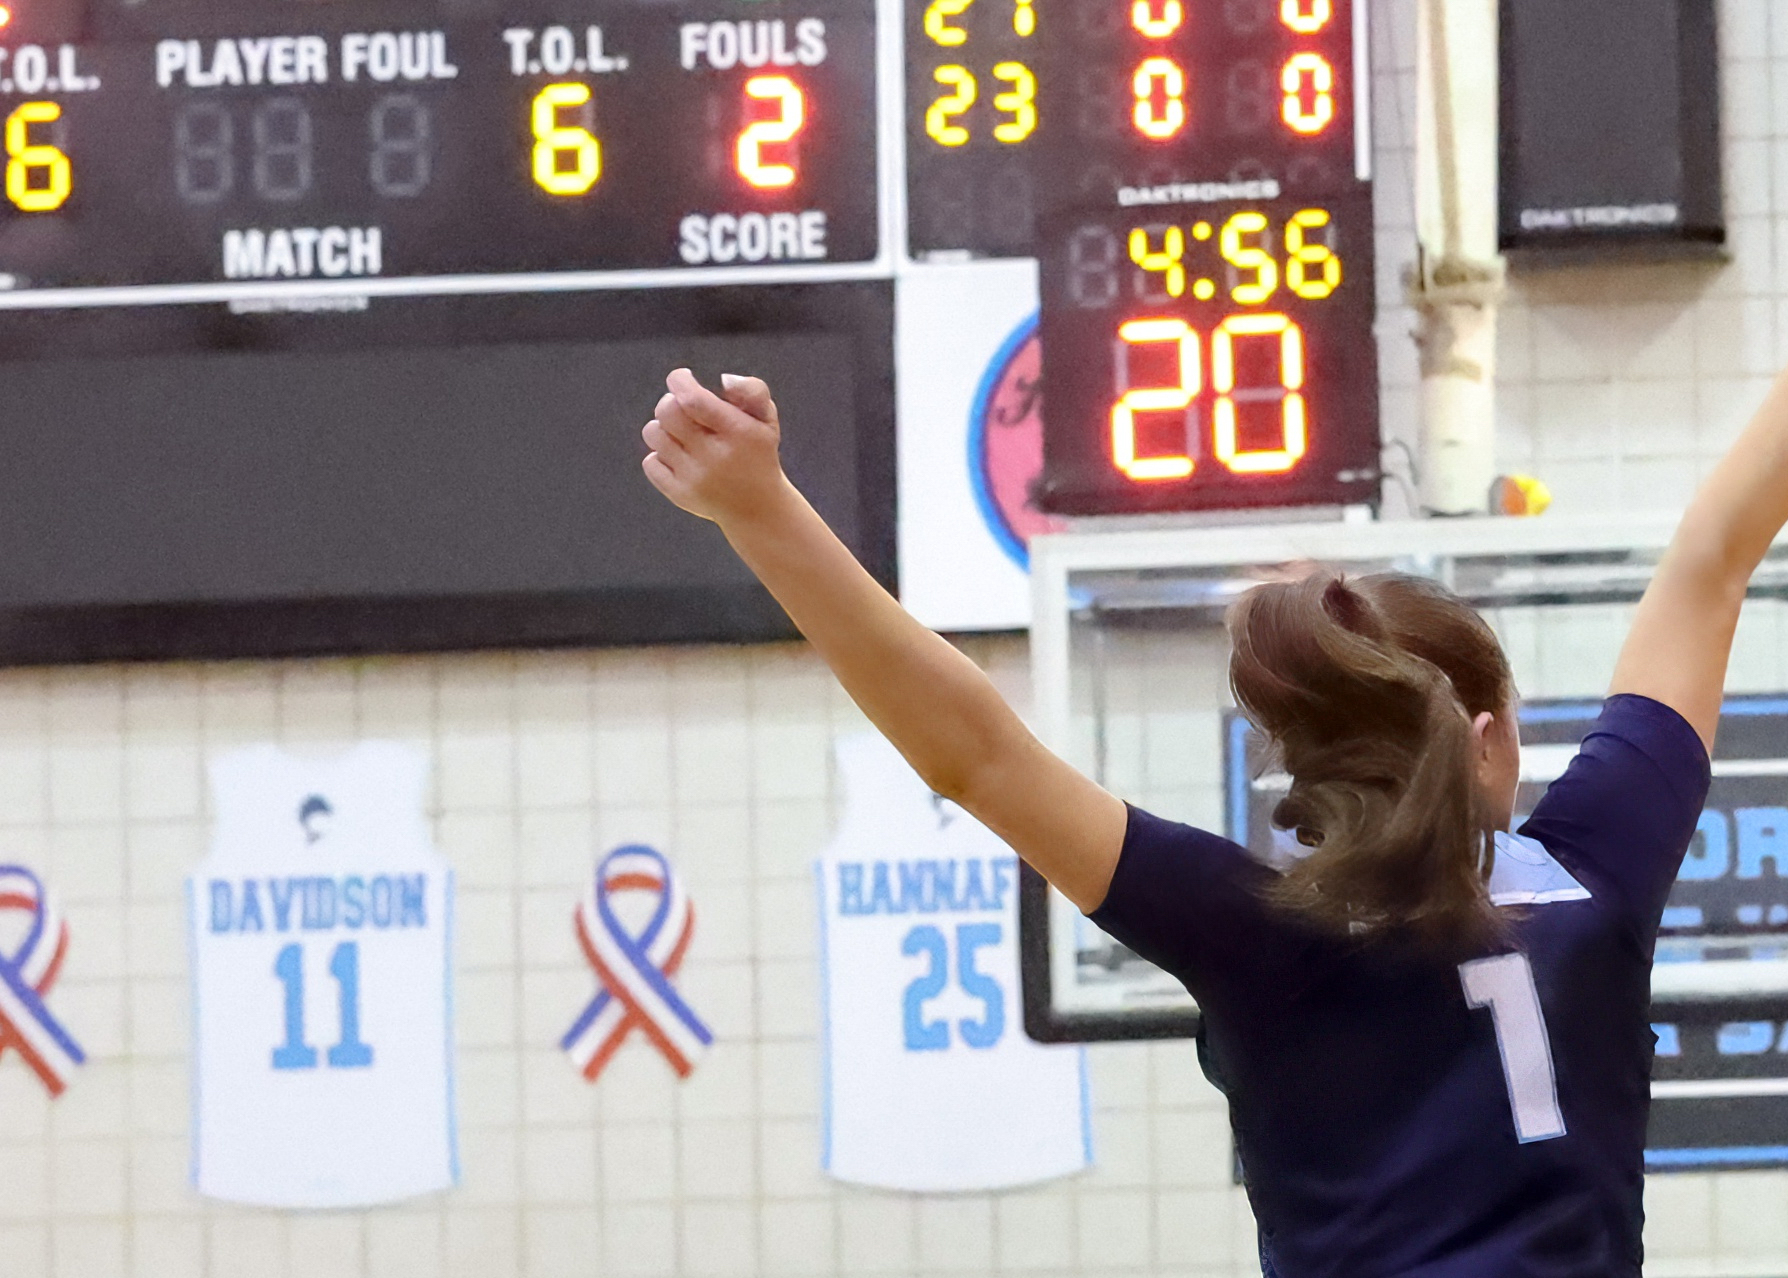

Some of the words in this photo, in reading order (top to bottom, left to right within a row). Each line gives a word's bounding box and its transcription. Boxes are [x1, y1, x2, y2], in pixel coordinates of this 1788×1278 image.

[0, 43, 101, 93] .O.L.
[155, 36, 329, 88] PLAYER
[340, 30, 459, 81] FOUL
[503, 25, 629, 76] T.O.L.
[679, 18, 828, 70] FOULS
[736, 74, 806, 189] 2
[925, 61, 1038, 147] 23
[1131, 56, 1185, 140] 0
[1279, 52, 1333, 135] 0
[5, 100, 73, 212] 6
[531, 81, 602, 196] 6
[222, 225, 383, 278] MATCH
[678, 211, 828, 264] SCORE
[1128, 207, 1343, 304] 4:56
[1110, 311, 1308, 482] 20
[208, 873, 426, 934] DAVIDSON
[271, 940, 374, 1070] 11
[902, 921, 1006, 1051] 25
[1457, 951, 1567, 1145] 1
